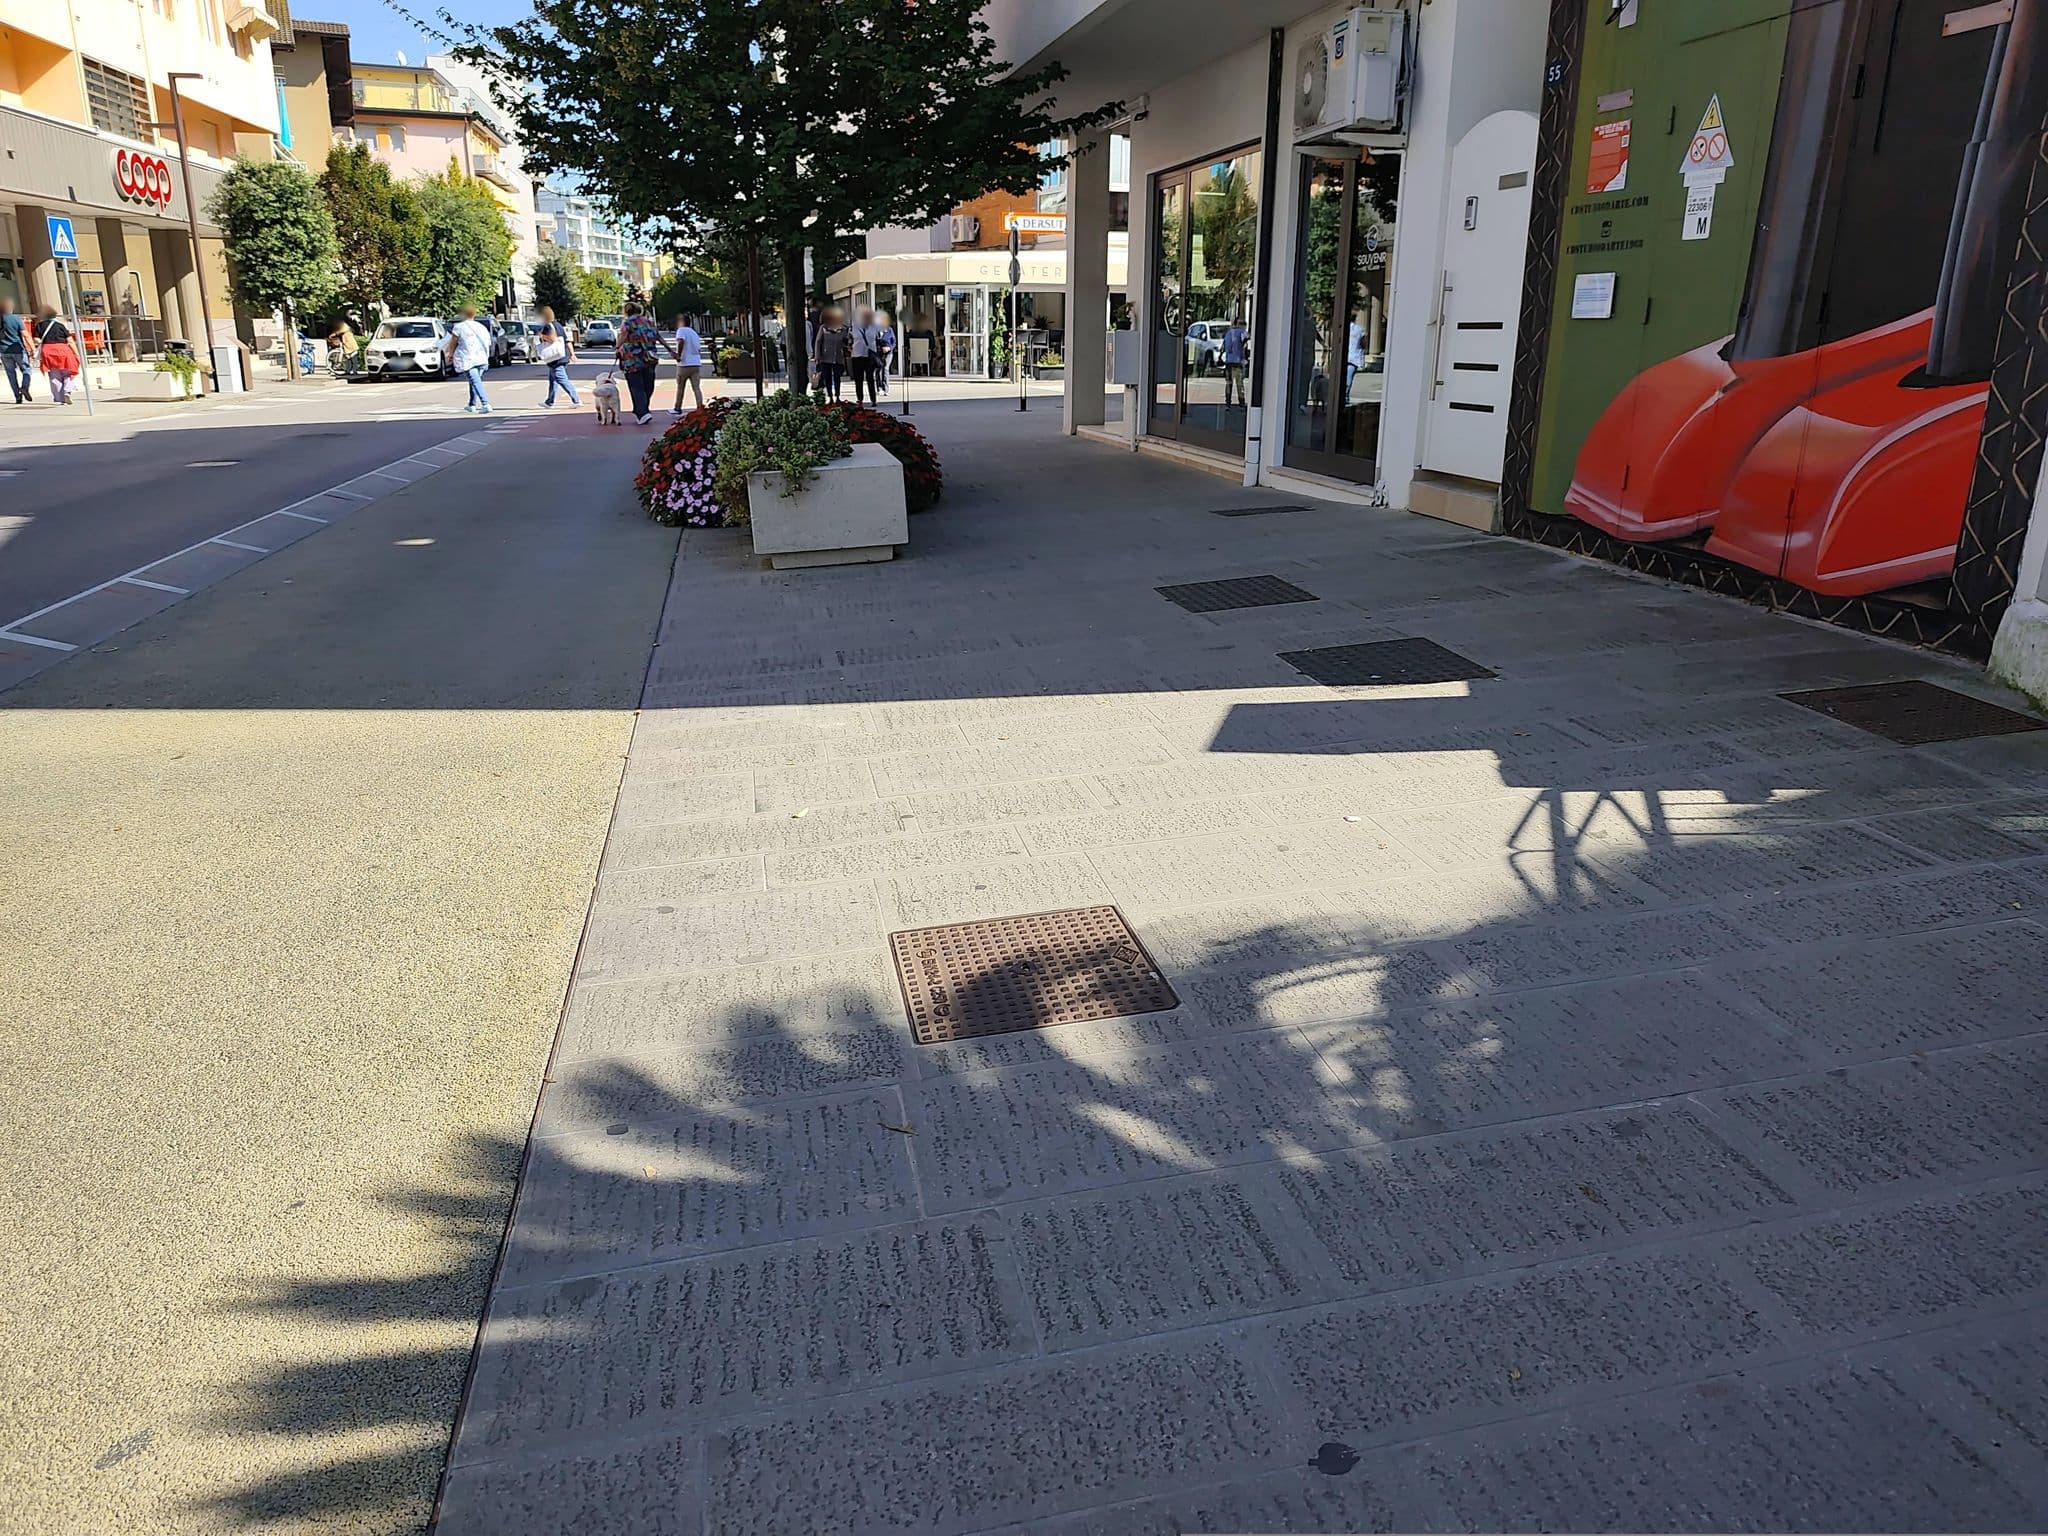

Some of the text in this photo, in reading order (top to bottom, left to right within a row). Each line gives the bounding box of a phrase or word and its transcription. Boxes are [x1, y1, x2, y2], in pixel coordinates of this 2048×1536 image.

[1548, 64, 1562, 82] 55
[1022, 218, 1064, 229] DERSUT
[1695, 216, 1708, 235] M
[1357, 251, 1387, 266] SOUVENIR
